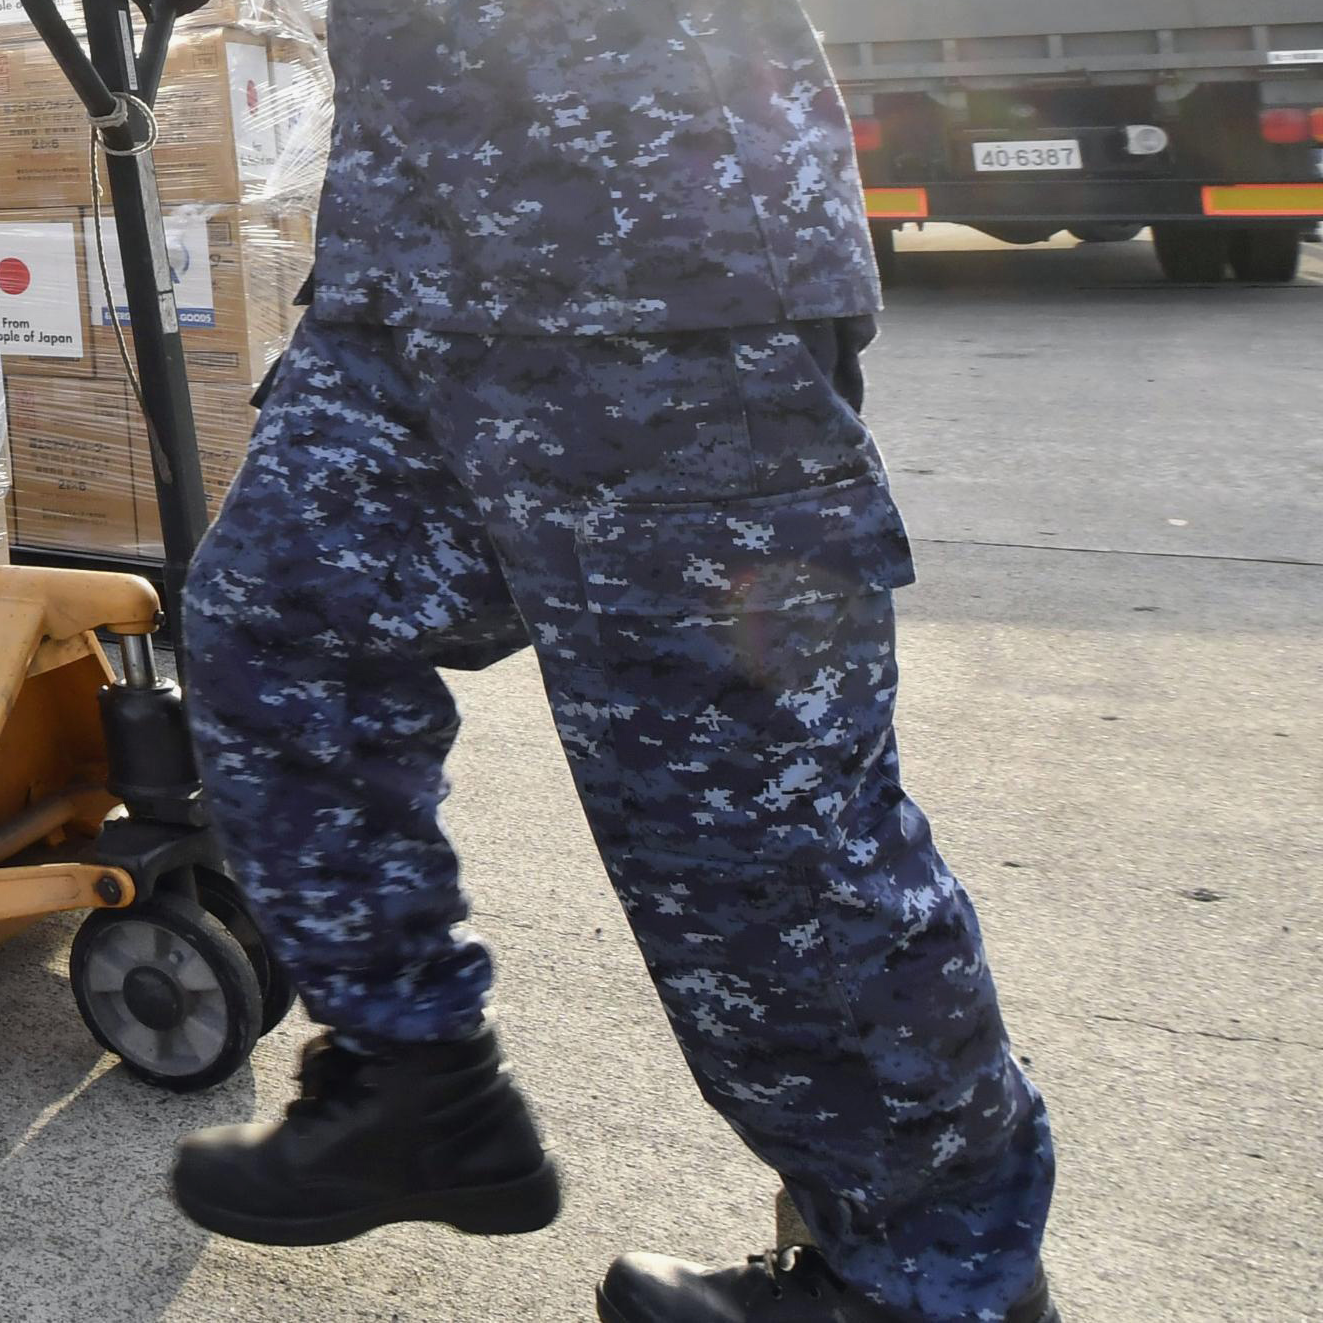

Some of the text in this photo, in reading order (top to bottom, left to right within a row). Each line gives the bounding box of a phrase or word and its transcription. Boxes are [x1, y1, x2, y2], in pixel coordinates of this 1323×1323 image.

[981, 147, 1074, 167] 40-6387
[2, 317, 30, 329] From
[179, 313, 212, 323] GOODS
[23, 330, 35, 343] of
[38, 331, 73, 346] Japan
